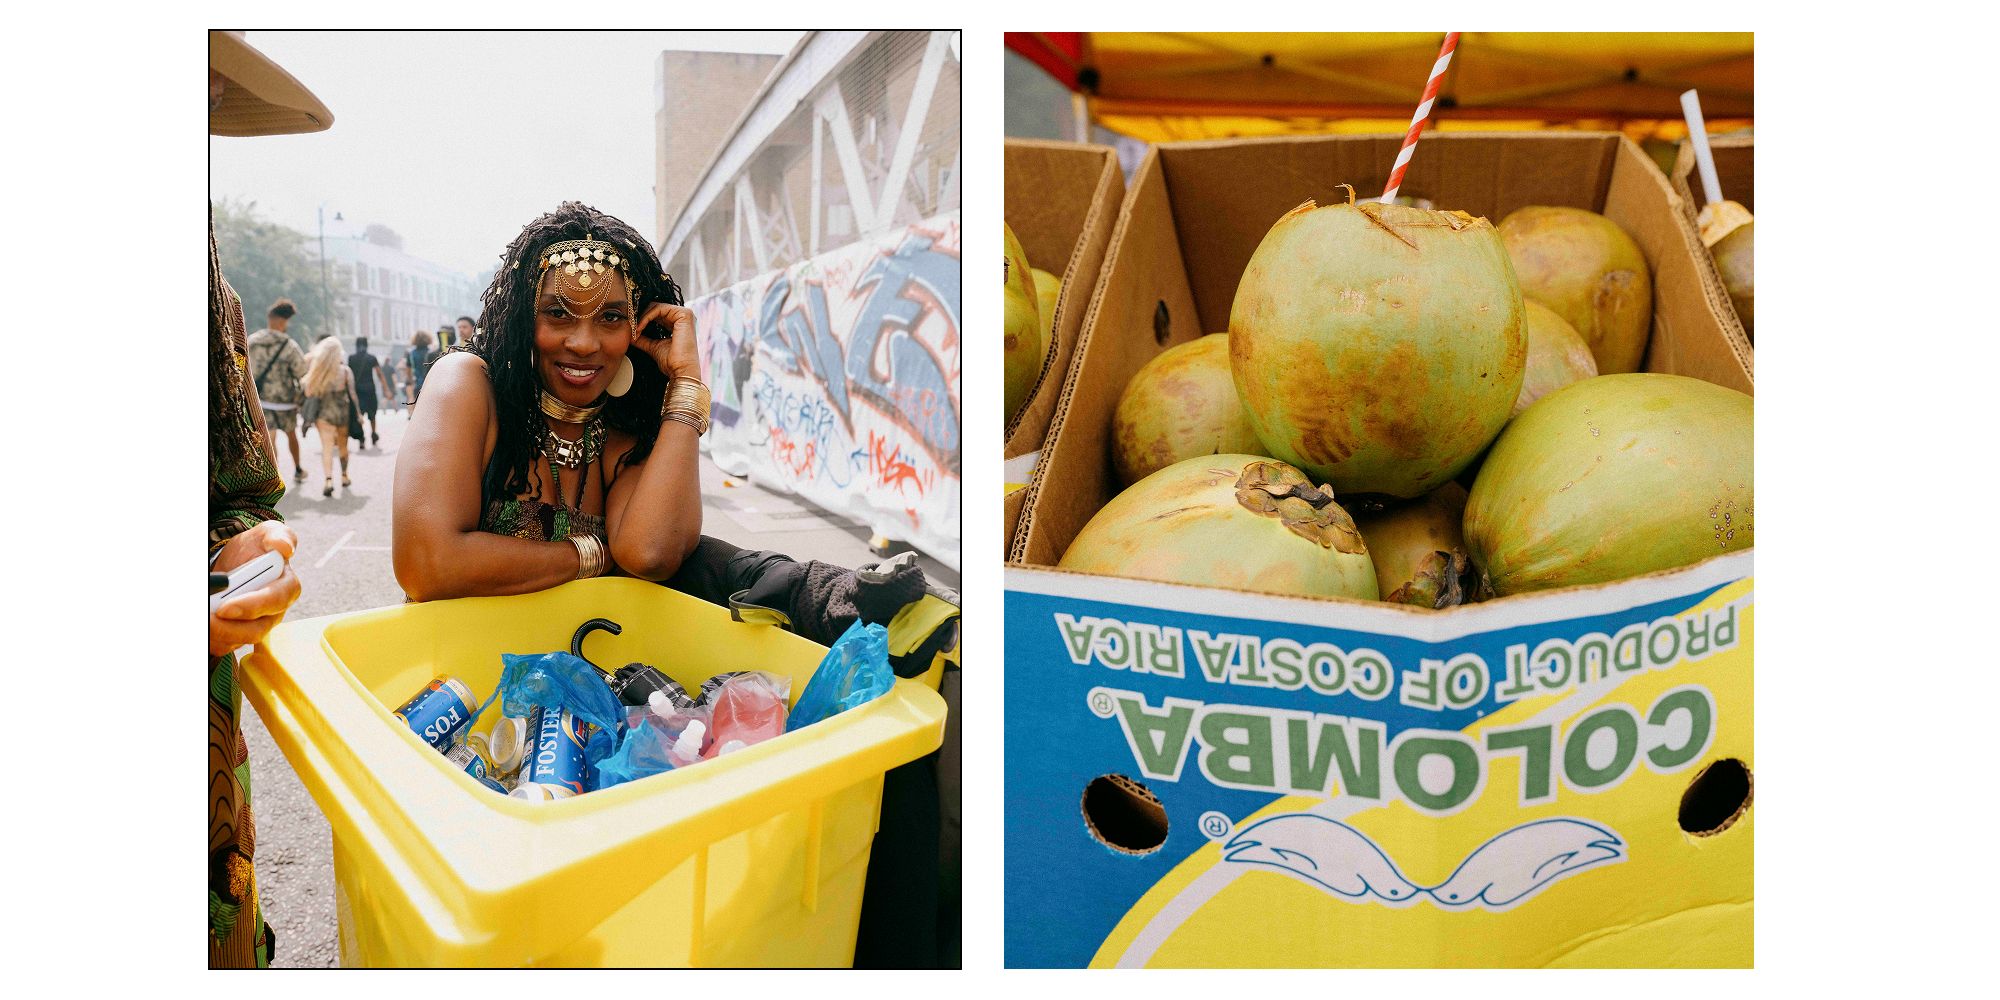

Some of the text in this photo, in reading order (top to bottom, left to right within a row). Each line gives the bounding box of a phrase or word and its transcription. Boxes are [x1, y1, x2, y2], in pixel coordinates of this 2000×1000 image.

[1061, 607, 1736, 706] PRODUCT OF COSTA RICA
[1116, 690, 1712, 811] COLOMBA
